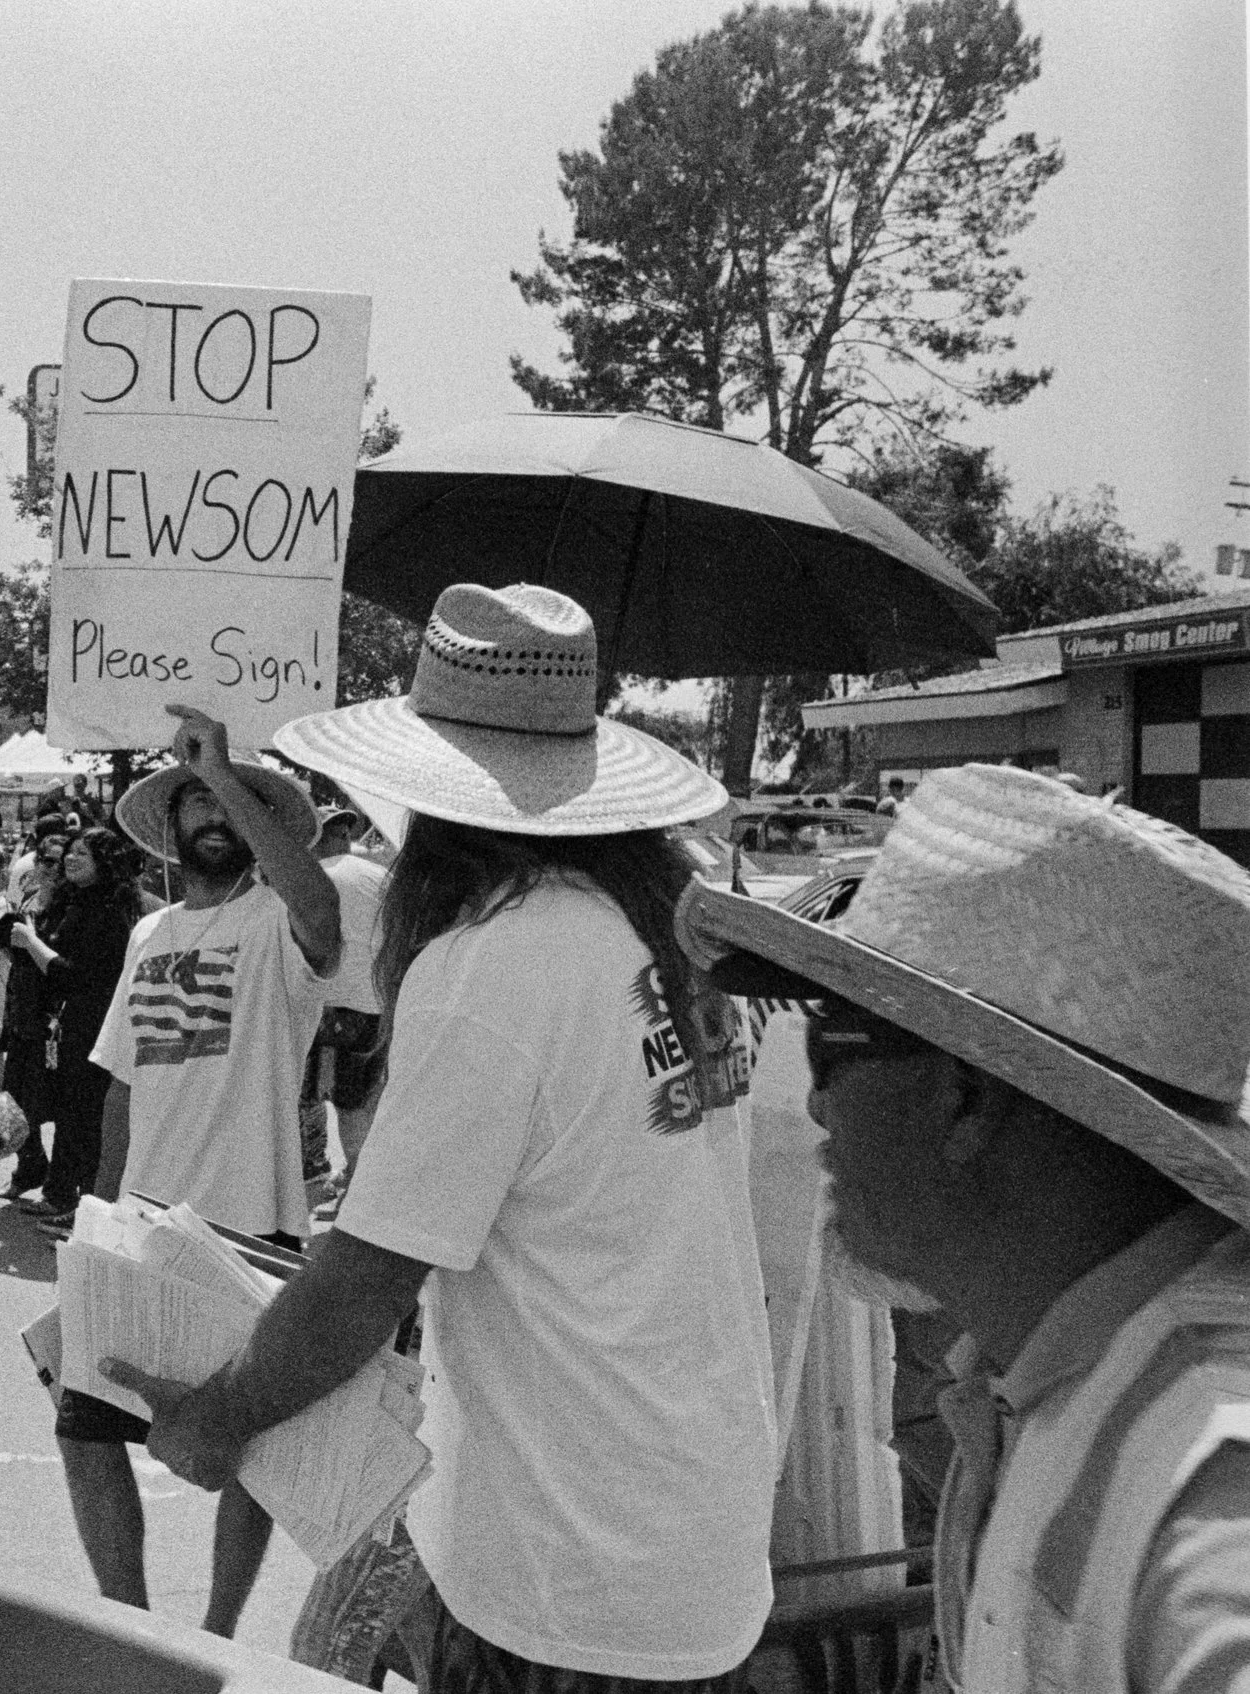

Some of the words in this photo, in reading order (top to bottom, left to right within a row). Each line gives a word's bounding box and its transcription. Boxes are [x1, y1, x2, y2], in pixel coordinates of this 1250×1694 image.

[80, 295, 320, 411] STOP
[57, 468, 339, 563] NEWSOM
[72, 618, 194, 684] Please
[210, 626, 322, 703] Sign!
[1123, 630, 1171, 653] Smog
[1175, 620, 1240, 647] Center
